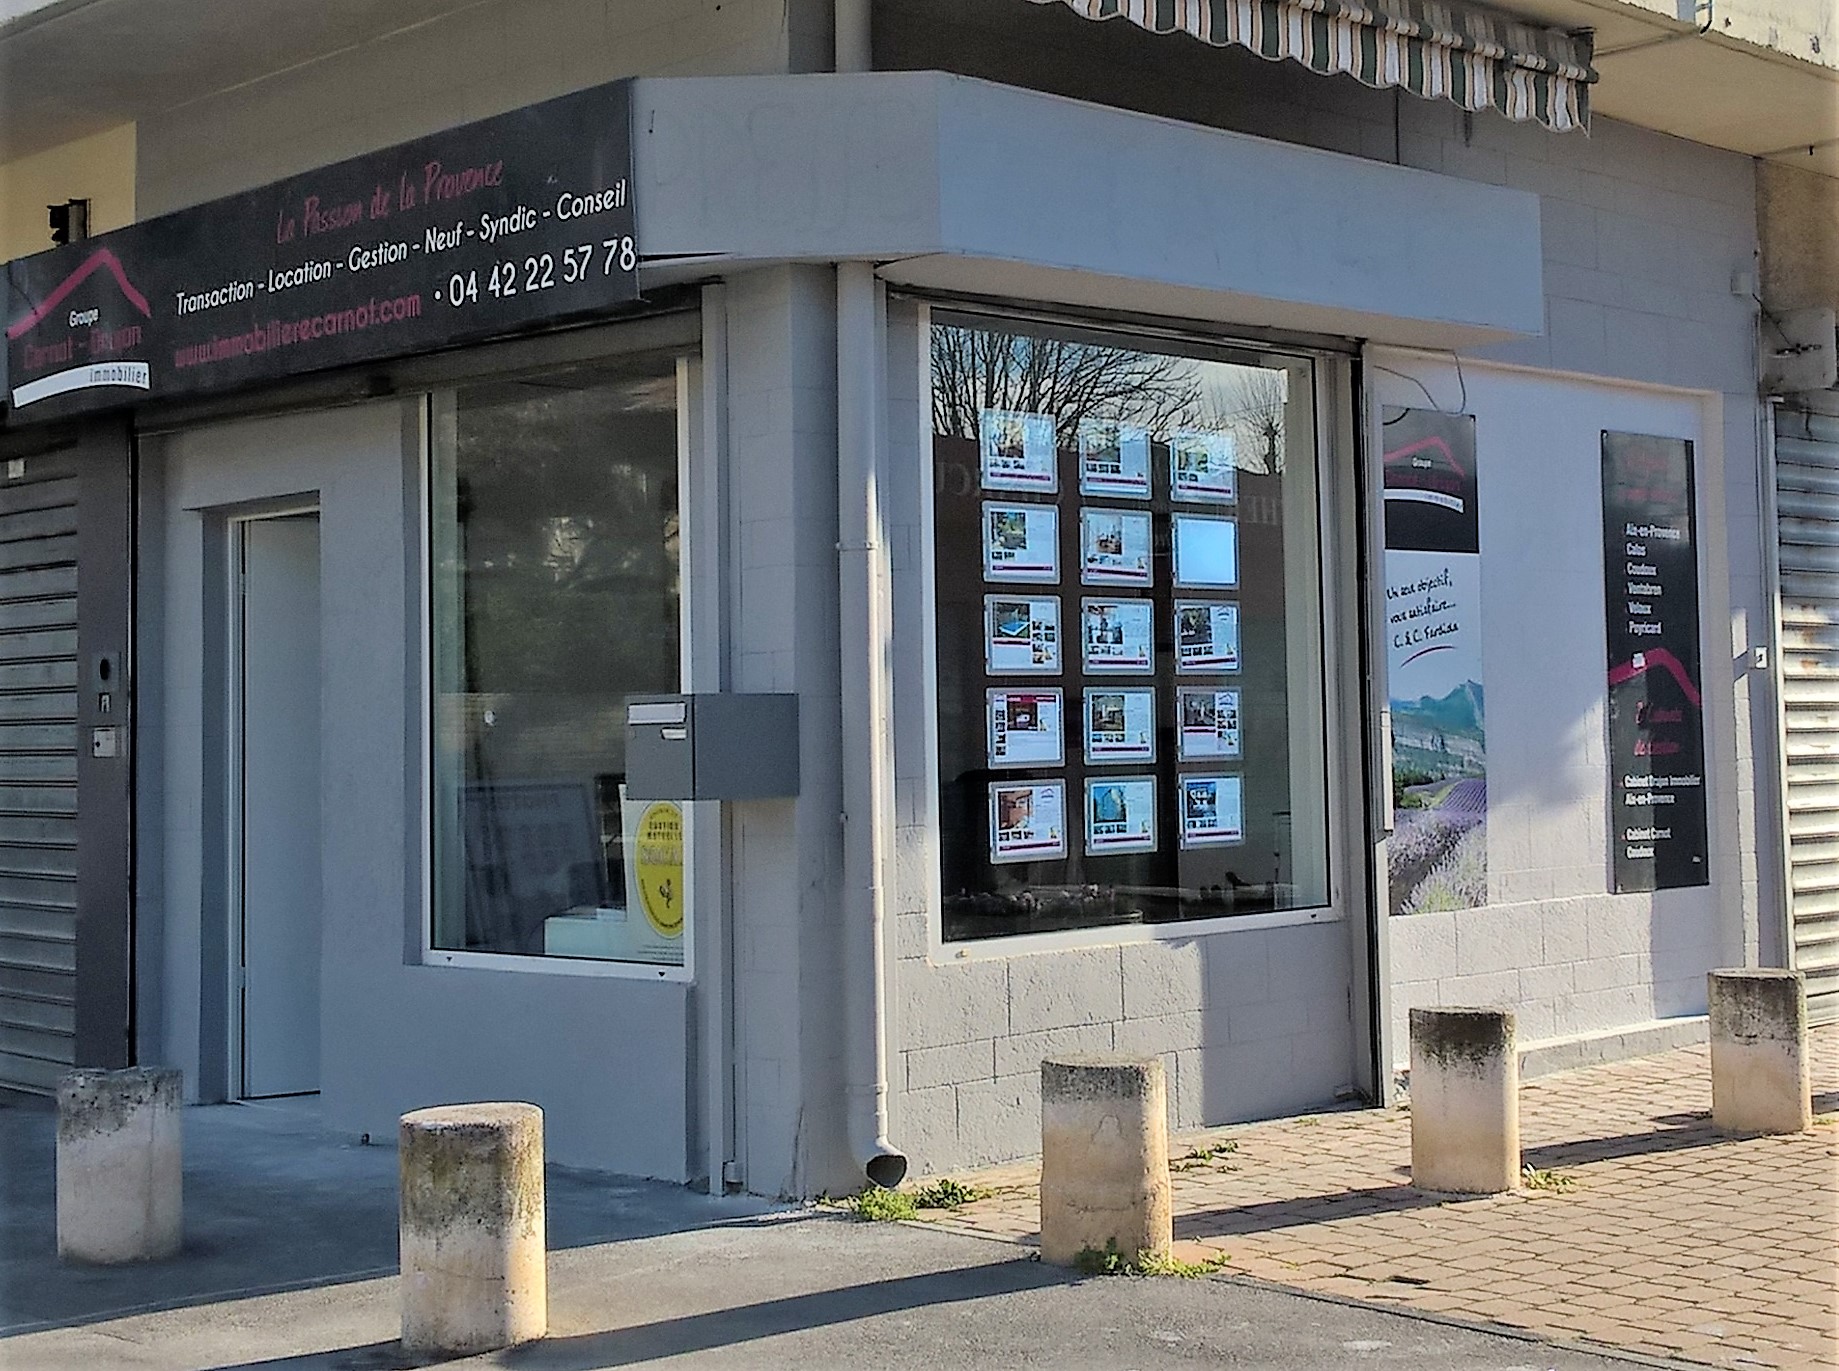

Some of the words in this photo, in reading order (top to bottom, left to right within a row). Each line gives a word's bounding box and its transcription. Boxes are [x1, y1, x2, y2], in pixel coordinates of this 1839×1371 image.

[370, 184, 390, 220] de
[424, 159, 504, 204] Provence
[176, 280, 254, 315] Transaction
[267, 260, 331, 293] Location
[348, 241, 408, 272] Gestion
[424, 221, 464, 254] Neuf
[479, 205, 537, 243] Syndic
[556, 178, 626, 220] Conseil
[69, 308, 99, 327] Groupe
[175, 294, 421, 368] www.immobilierecarnot.com
[449, 270, 479, 307] 04
[488, 261, 517, 298] 42
[524, 253, 555, 292] 22
[563, 245, 593, 284] 57
[602, 235, 636, 275] 78
[89, 366, 147, 384] immobilier
[1626, 522, 1680, 539] Aix-en-Provence
